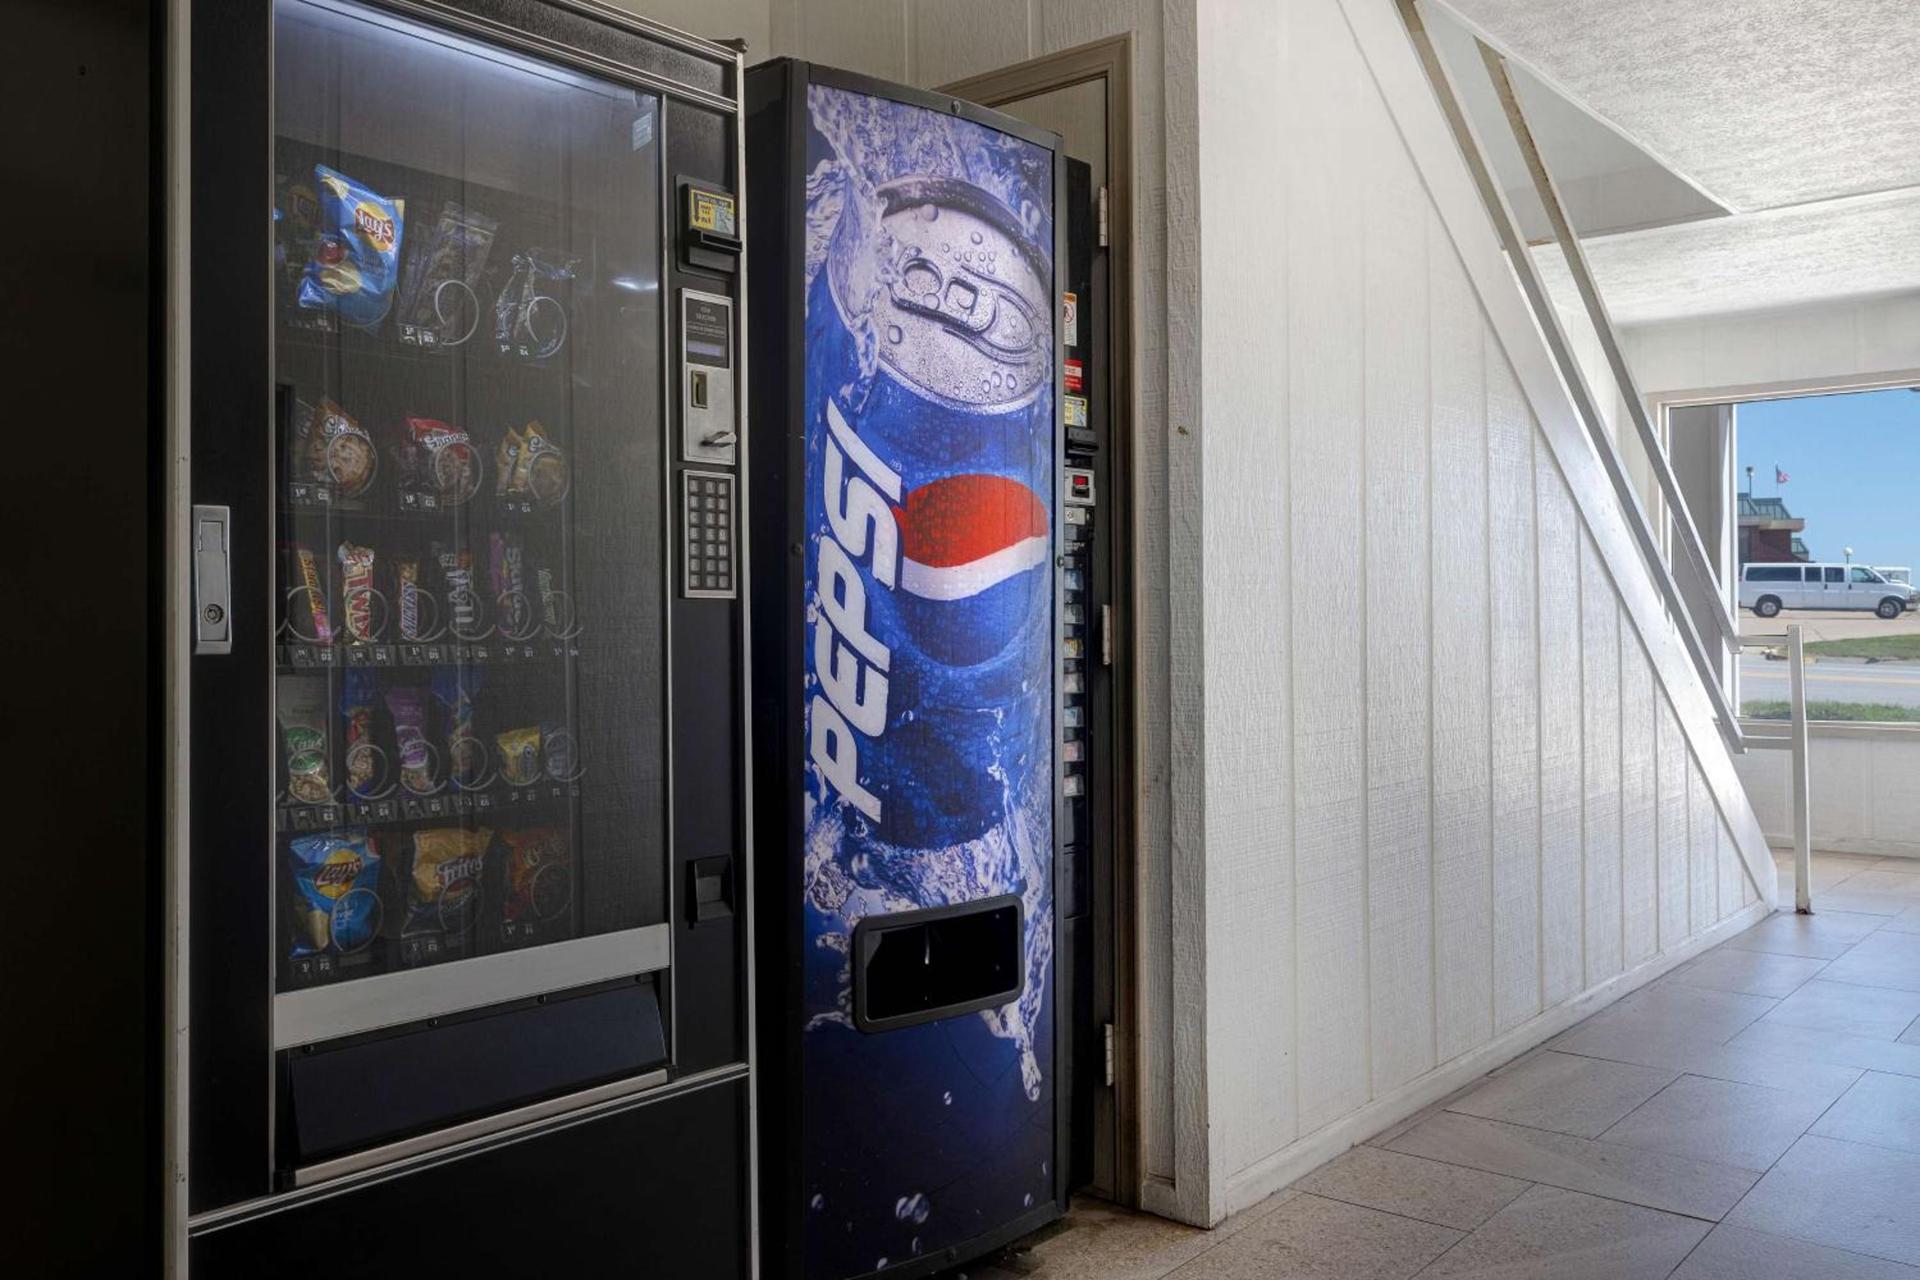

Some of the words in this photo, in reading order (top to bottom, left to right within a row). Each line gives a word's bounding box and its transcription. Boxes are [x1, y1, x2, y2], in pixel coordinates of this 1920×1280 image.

[356, 208, 394, 245] Lay's
[810, 396, 902, 824] PEPSI
[316, 857, 362, 886] Lay's
[436, 856, 483, 888] Fritos
